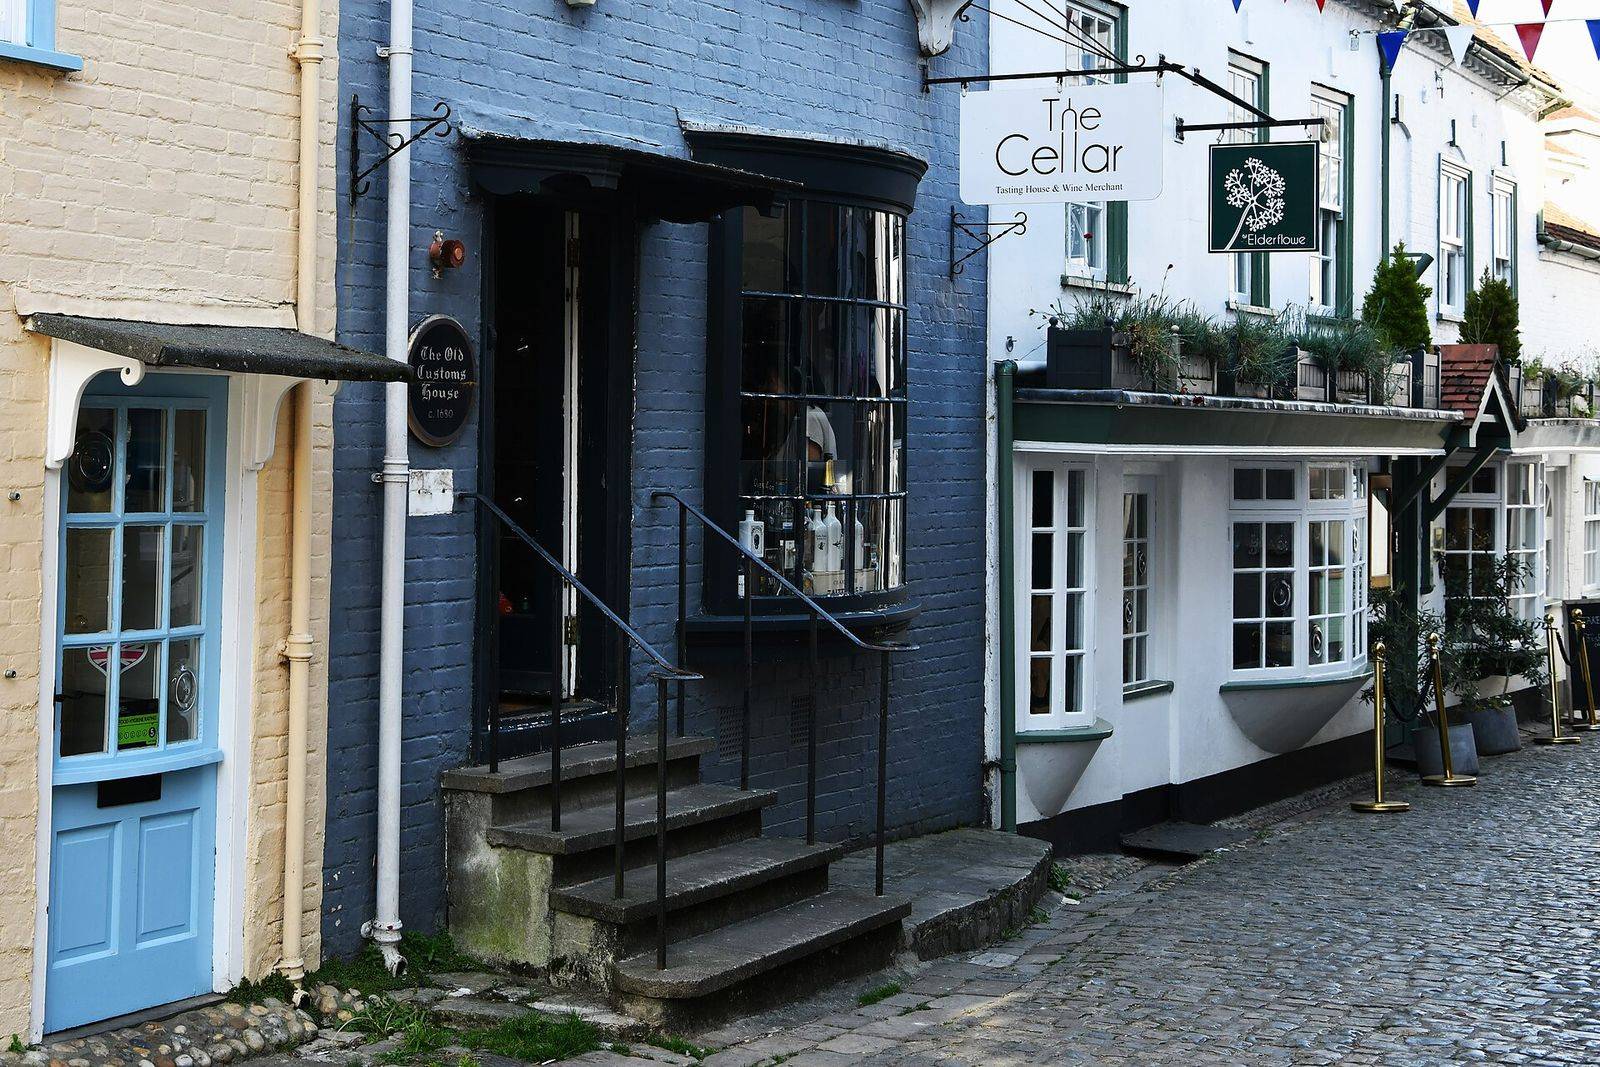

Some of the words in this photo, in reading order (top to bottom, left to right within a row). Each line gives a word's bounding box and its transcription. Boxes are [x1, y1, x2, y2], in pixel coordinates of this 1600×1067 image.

[1042, 97, 1101, 131] The
[995, 131, 1123, 176] Cellar
[995, 185, 1023, 195] Tasting
[1025, 185, 1051, 194] House
[1051, 184, 1060, 193] &
[1062, 183, 1083, 192] Wine
[1085, 182, 1123, 192] Merchant
[420, 346, 442, 361] The
[444, 346, 464, 361] Old
[417, 364, 467, 381] Customs
[421, 383, 459, 400] House
